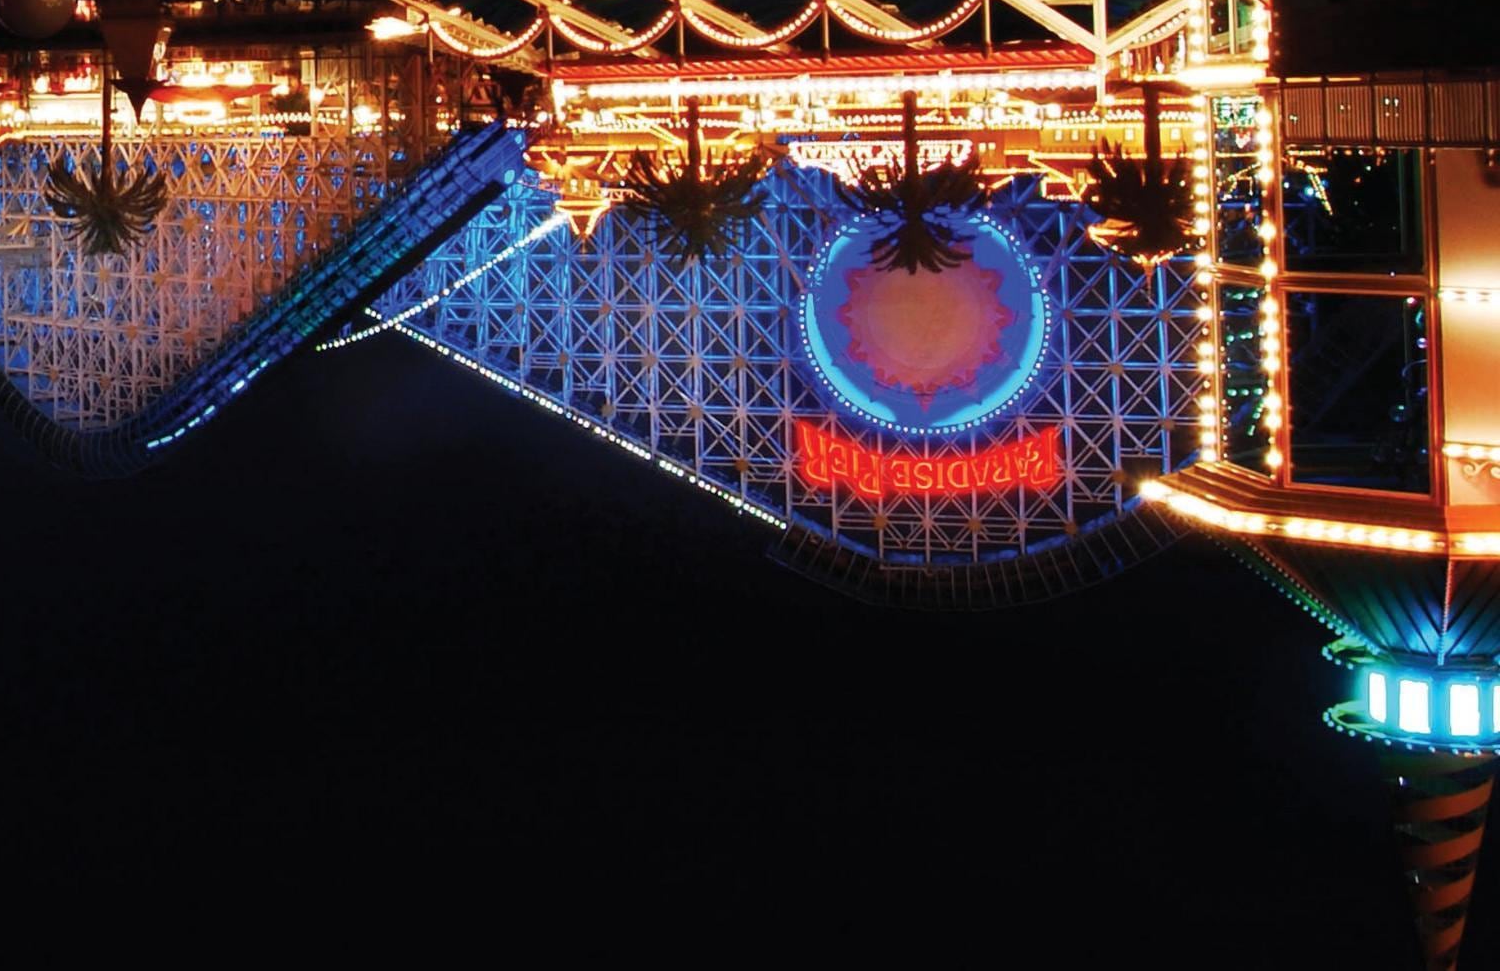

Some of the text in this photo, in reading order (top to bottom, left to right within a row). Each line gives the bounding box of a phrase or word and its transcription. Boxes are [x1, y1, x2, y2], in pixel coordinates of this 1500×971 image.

[877, 144, 960, 160] MIDAY
[797, 421, 1058, 497] PARADISE PIER
